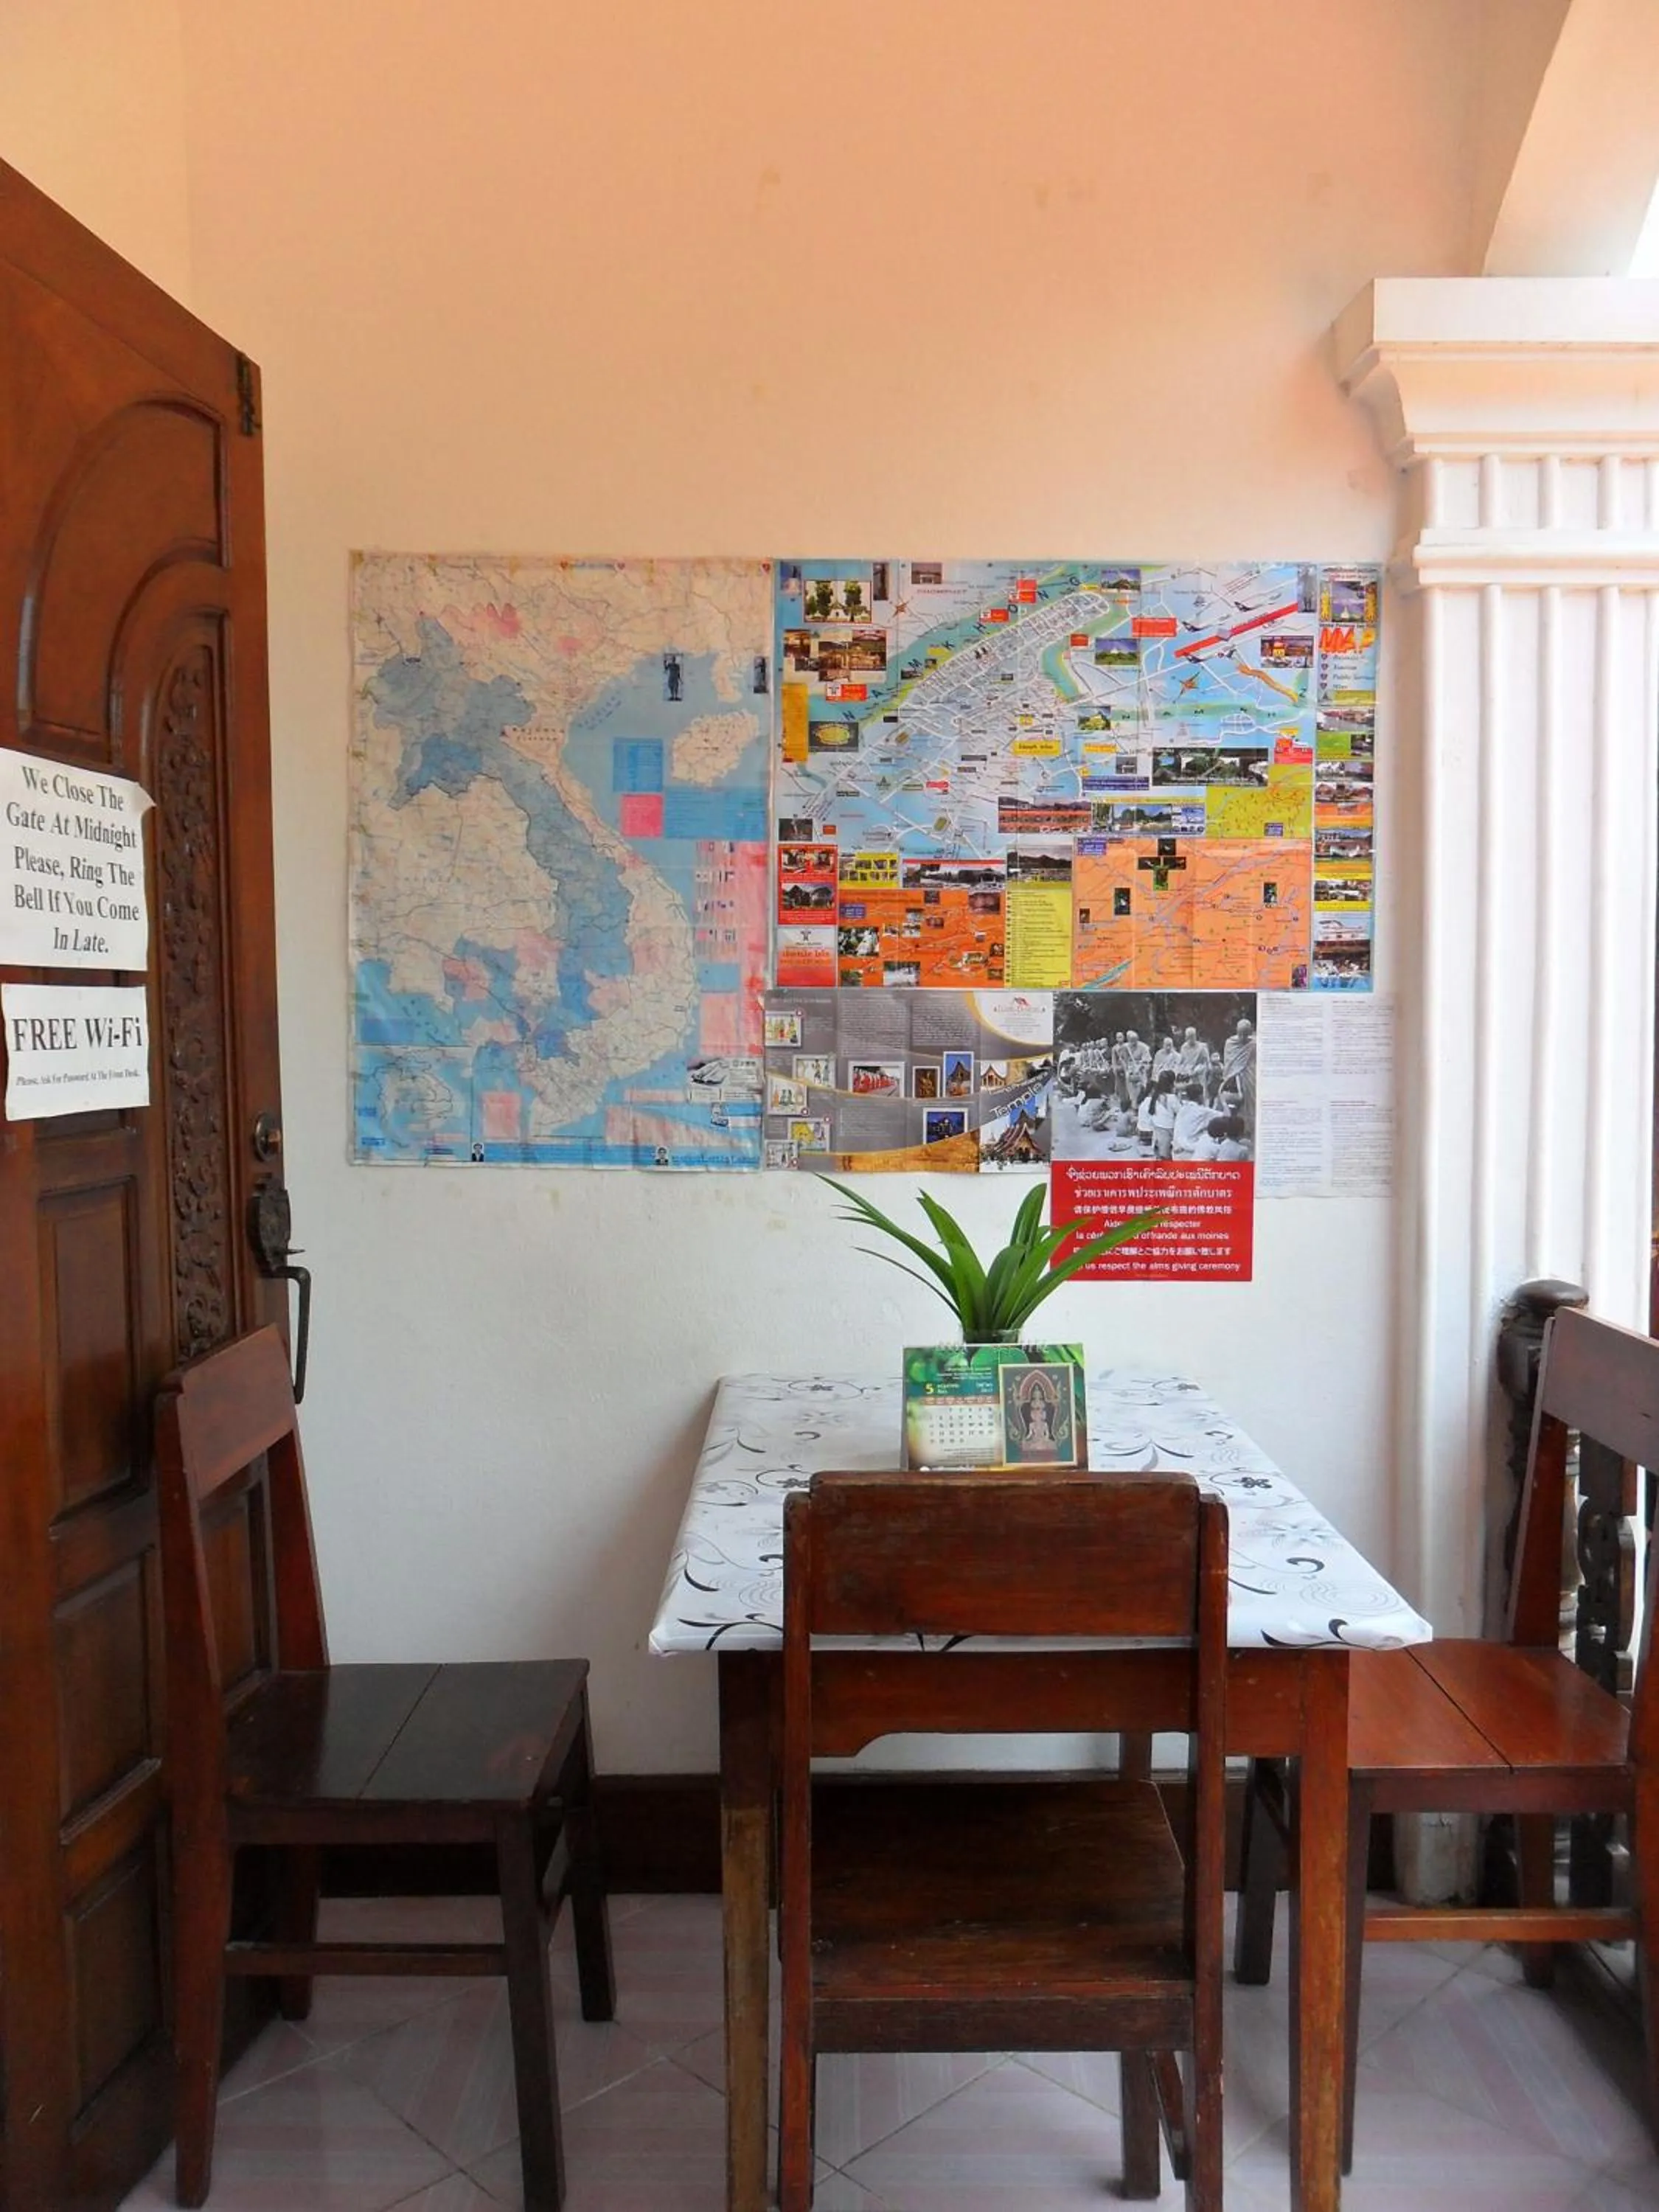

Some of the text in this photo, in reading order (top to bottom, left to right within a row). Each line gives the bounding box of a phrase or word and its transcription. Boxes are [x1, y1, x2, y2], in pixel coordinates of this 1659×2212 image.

[21, 766, 124, 811] We Close The
[6, 801, 137, 852] Gate At Midnight
[14, 846, 135, 887] Please, Ring The
[14, 885, 140, 922] Bell If You Come
[53, 927, 109, 953] In Late.
[13, 1016, 142, 1052] FREE Wi-Fi
[989, 1082, 1043, 1117] Temple
[1076, 1231, 1084, 1239] la
[1197, 1231, 1229, 1239] moines
[1160, 1220, 1201, 1229] respecter
[1098, 1262, 1131, 1272] respect
[1133, 1262, 1147, 1270] the
[1149, 1262, 1170, 1270] alms
[1172, 1262, 1197, 1273] giving
[1198, 1263, 1241, 1273] ceremony
